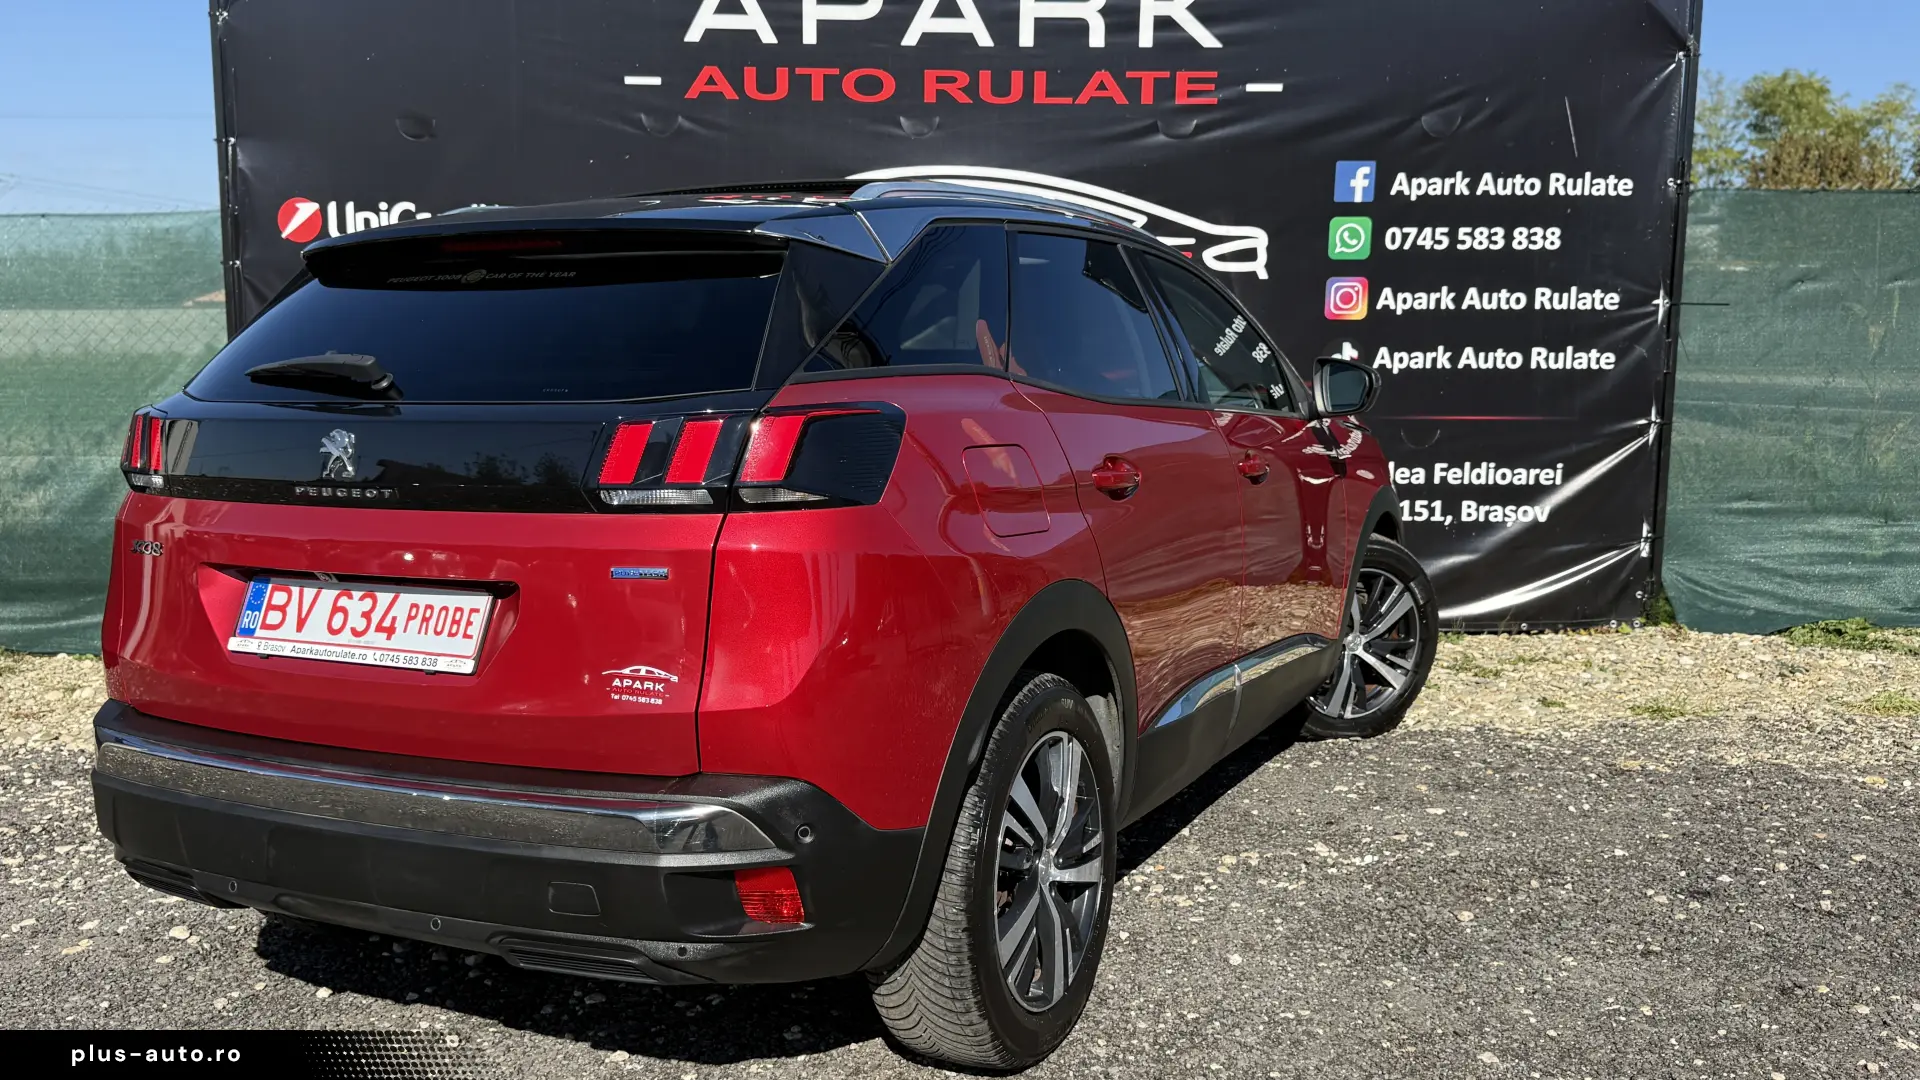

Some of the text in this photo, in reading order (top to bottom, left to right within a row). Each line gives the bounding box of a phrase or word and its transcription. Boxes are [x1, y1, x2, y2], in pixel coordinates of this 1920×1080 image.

[685, 66, 1218, 105] AUTO RULATE
[1390, 171, 1634, 202] Apark Auto Rulate
[1385, 226, 1562, 251] 0745 583 838
[387, 275, 434, 284] PEUGEOT
[486, 272, 505, 280] CAR
[507, 271, 523, 279] OF
[526, 270, 546, 279] THE
[549, 270, 577, 278] YEAR
[1376, 286, 1620, 316] Apark Auto Rulate
[1373, 345, 1616, 376] Apark Auto Rulate
[1434, 462, 1564, 486] Feldioarei
[294, 485, 393, 499] PEUGEOT
[1399, 499, 1551, 528] 151, Brașov
[241, 610, 259, 629] RO
[259, 584, 481, 641] BV 634 PROBE
[290, 645, 368, 661] Aparkautorulate.ro
[379, 652, 400, 664] 0745
[402, 656, 419, 666] 583
[421, 658, 438, 668] 838
[612, 678, 665, 692] APARK
[621, 694, 637, 702] 0745
[638, 696, 650, 704] 583
